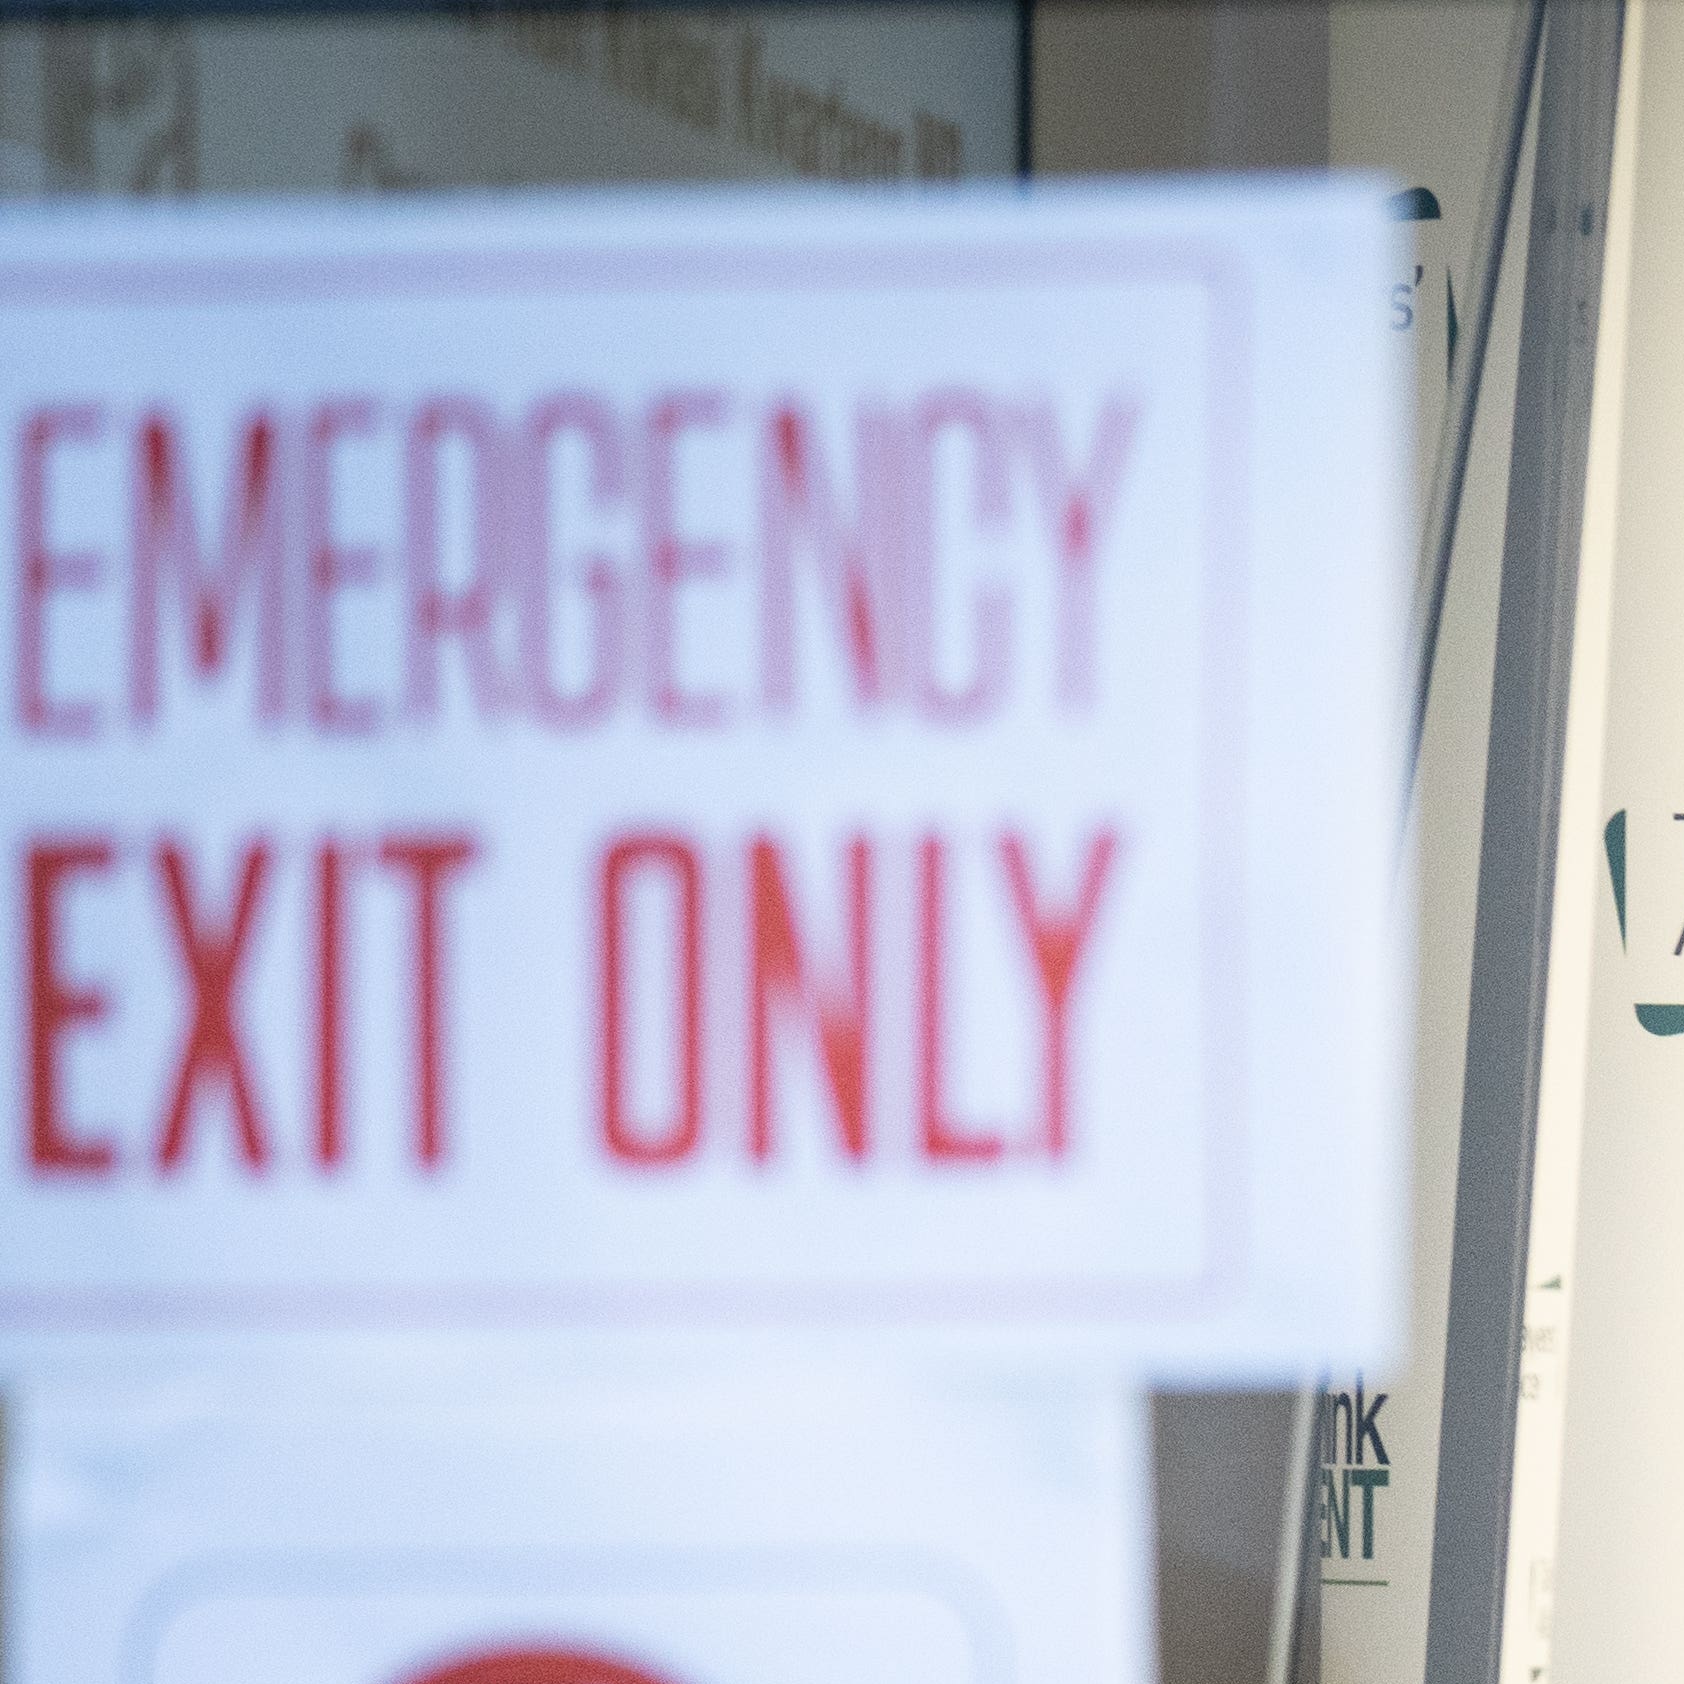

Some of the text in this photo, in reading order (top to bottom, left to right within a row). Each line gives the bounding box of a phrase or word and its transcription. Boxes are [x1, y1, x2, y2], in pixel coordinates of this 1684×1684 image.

[14, 384, 1145, 740] EMERGENCY
[22, 826, 1121, 1180] EXIT ONLY
